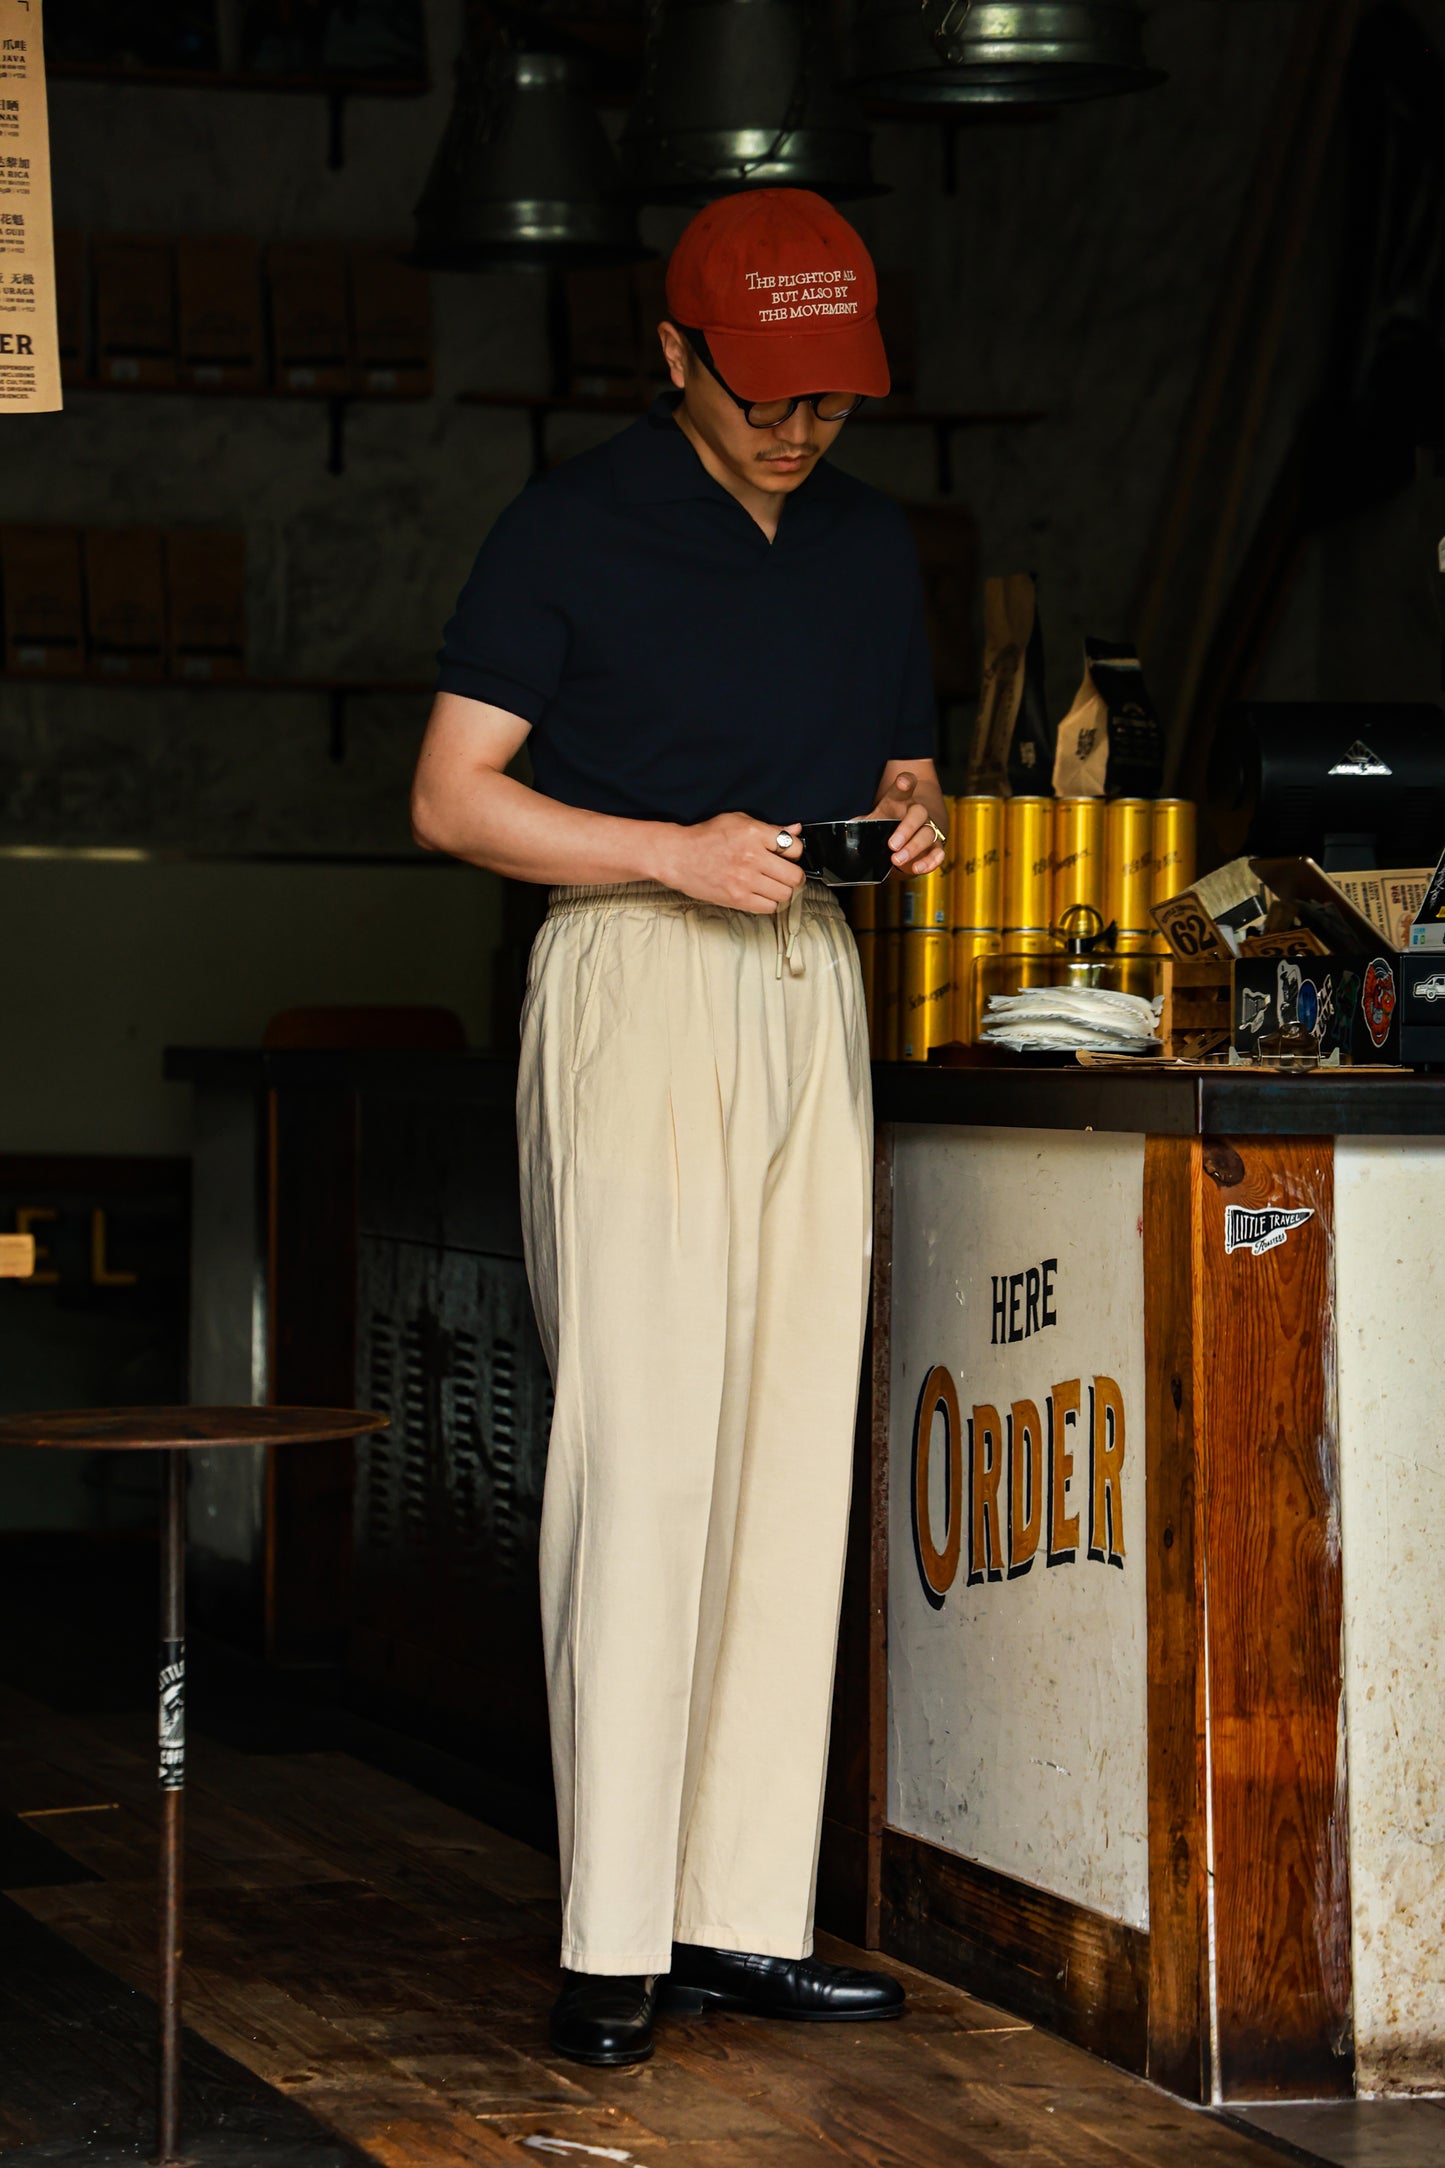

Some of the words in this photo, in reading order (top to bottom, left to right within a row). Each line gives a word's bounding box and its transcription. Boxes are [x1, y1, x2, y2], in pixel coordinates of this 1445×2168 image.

[2, 55, 26, 63] JAVA
[746, 272, 776, 290] THE
[771, 291, 799, 304] BUT
[801, 287, 833, 301] ALSO
[834, 286, 849, 299] BY
[759, 308, 788, 322] THE
[789, 302, 858, 319] MOVEMENT
[1171, 915, 1219, 955] 62
[1235, 1213, 1267, 1242] LITTLE
[1269, 1213, 1301, 1230] TRAVEL
[990, 1257, 1059, 1345] HERE
[910, 1364, 1127, 1611] ORDER
